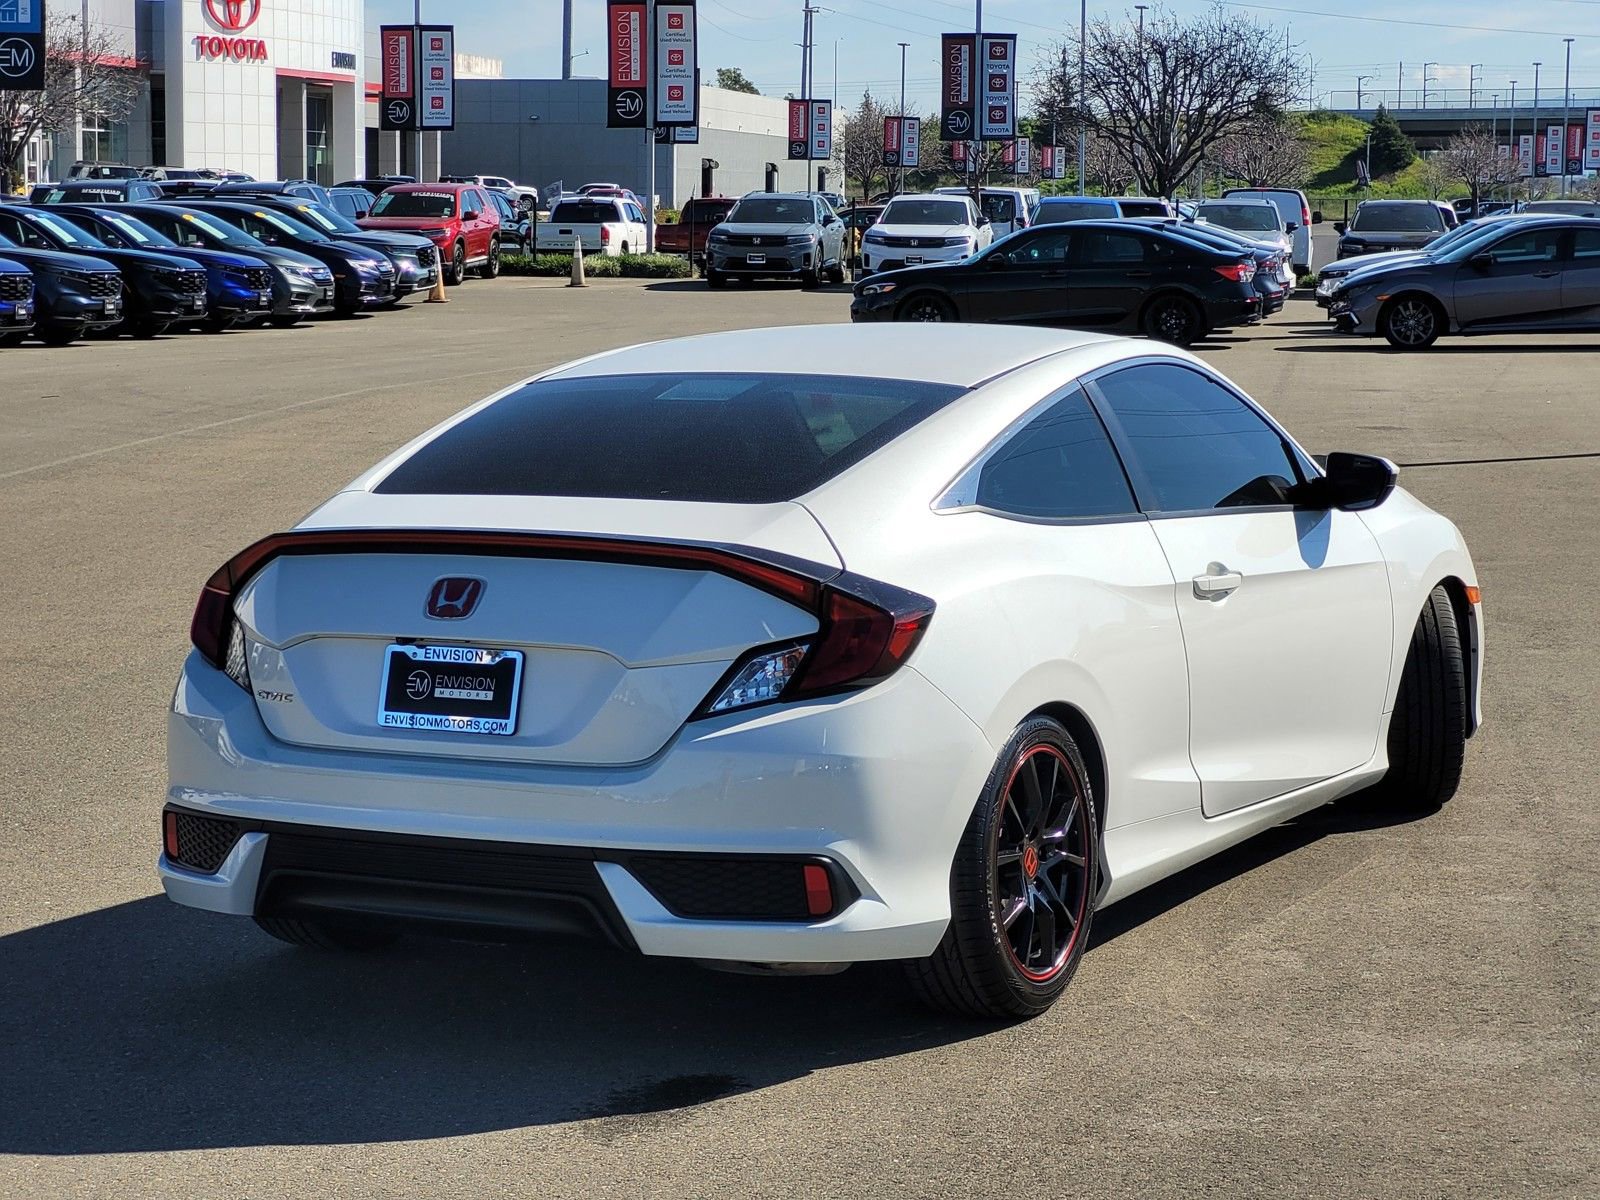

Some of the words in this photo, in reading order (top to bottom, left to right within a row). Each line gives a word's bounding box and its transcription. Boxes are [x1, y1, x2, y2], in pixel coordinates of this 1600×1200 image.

[197, 36, 268, 60] TOYOTA
[618, 11, 630, 81] ENVISION
[389, 35, 400, 93] ENVISION
[950, 45, 961, 103] ENVISION
[424, 647, 484, 662] ENVISION
[435, 674, 496, 691] ENVISION
[258, 690, 294, 703] CIVIC
[439, 690, 489, 699] MOTORS
[384, 714, 508, 732] ENVISIONMOTORS.COM
